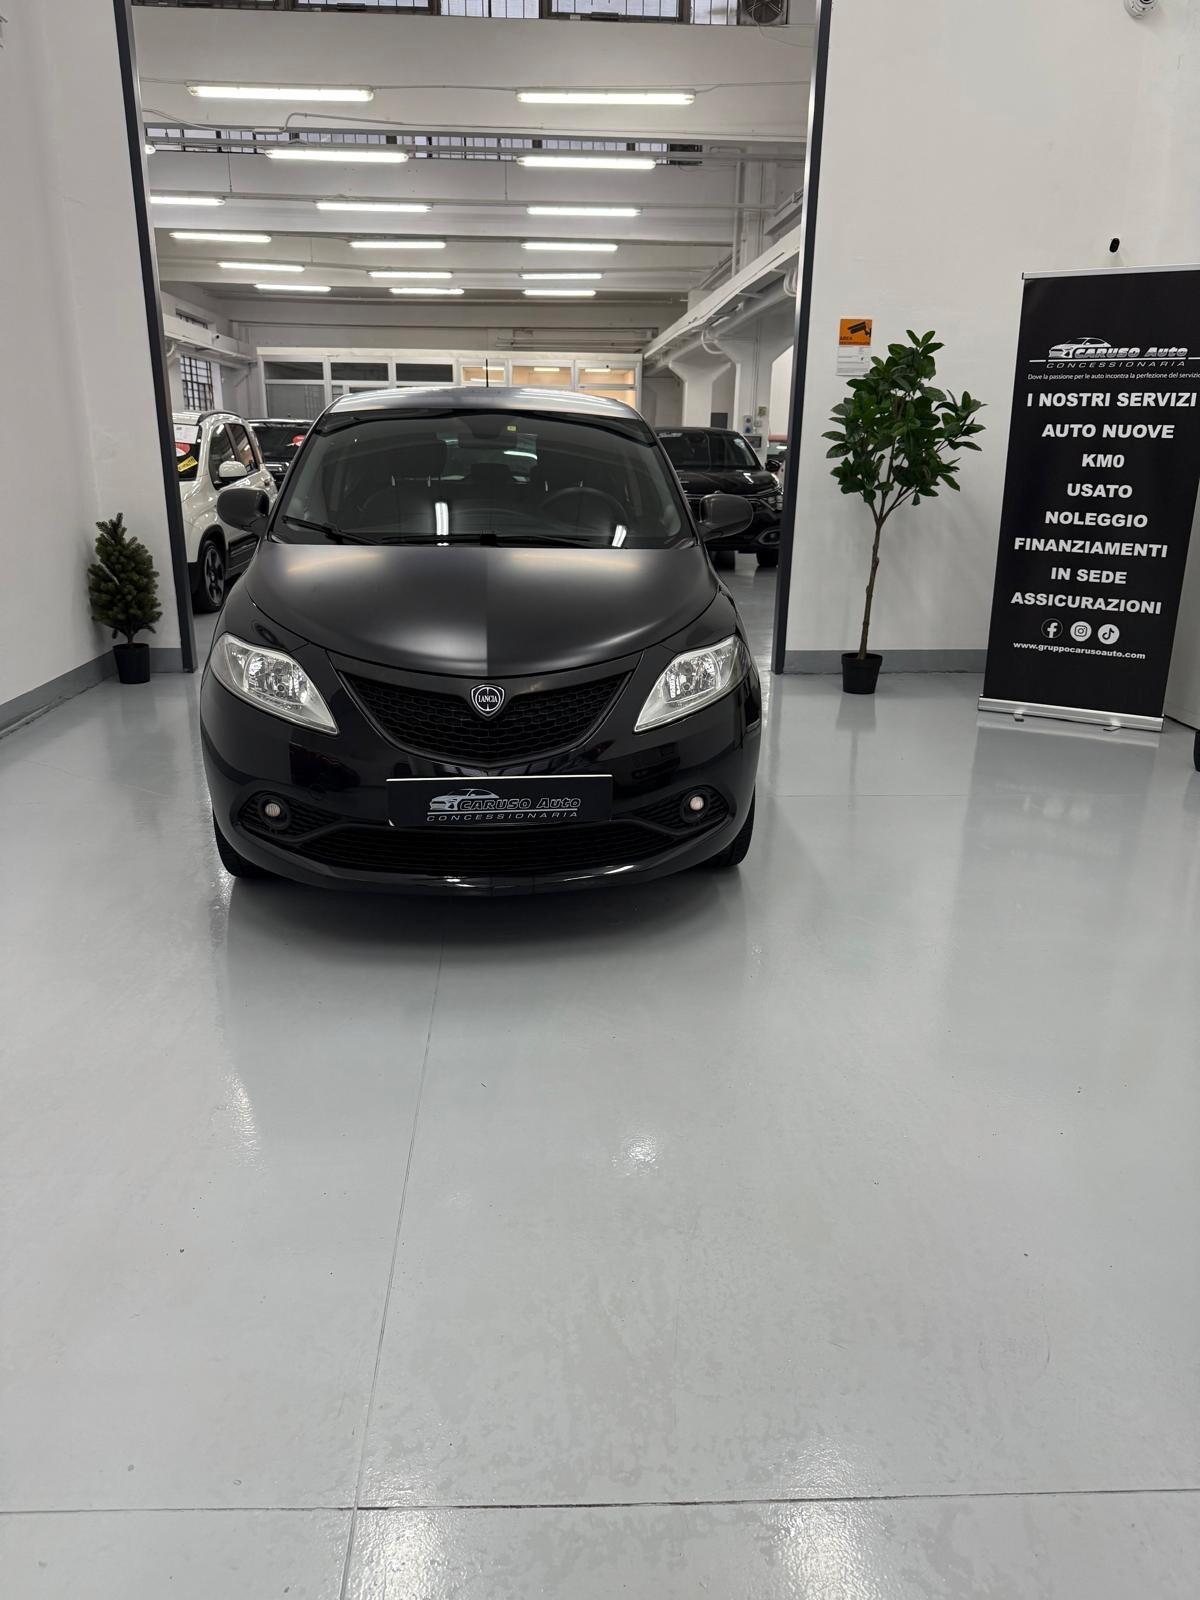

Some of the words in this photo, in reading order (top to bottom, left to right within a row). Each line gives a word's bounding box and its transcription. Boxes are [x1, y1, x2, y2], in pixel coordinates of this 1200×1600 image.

[1046, 361, 1185, 369] CONCESSIONARIA
[1049, 373, 1073, 381] passione
[1027, 393, 1033, 407] I
[1039, 393, 1110, 407] NOSTRI
[1117, 392, 1197, 407] SERVIZI
[1042, 424, 1096, 438] AUTO
[1102, 425, 1175, 439] NUOVE
[1067, 483, 1133, 499] USATO
[1045, 511, 1148, 528] NOLEGGIO
[1014, 537, 1168, 558] FINANZIAMENTI
[1051, 567, 1071, 580] IN
[1076, 568, 1127, 585] SEDE
[1010, 592, 1162, 615] ASSICURAZIONI
[1013, 642, 1146, 660] www.gruppocarusoauto.com
[479, 695, 498, 703] LANCIA
[426, 812, 577, 822] CONCESSIONARIA
